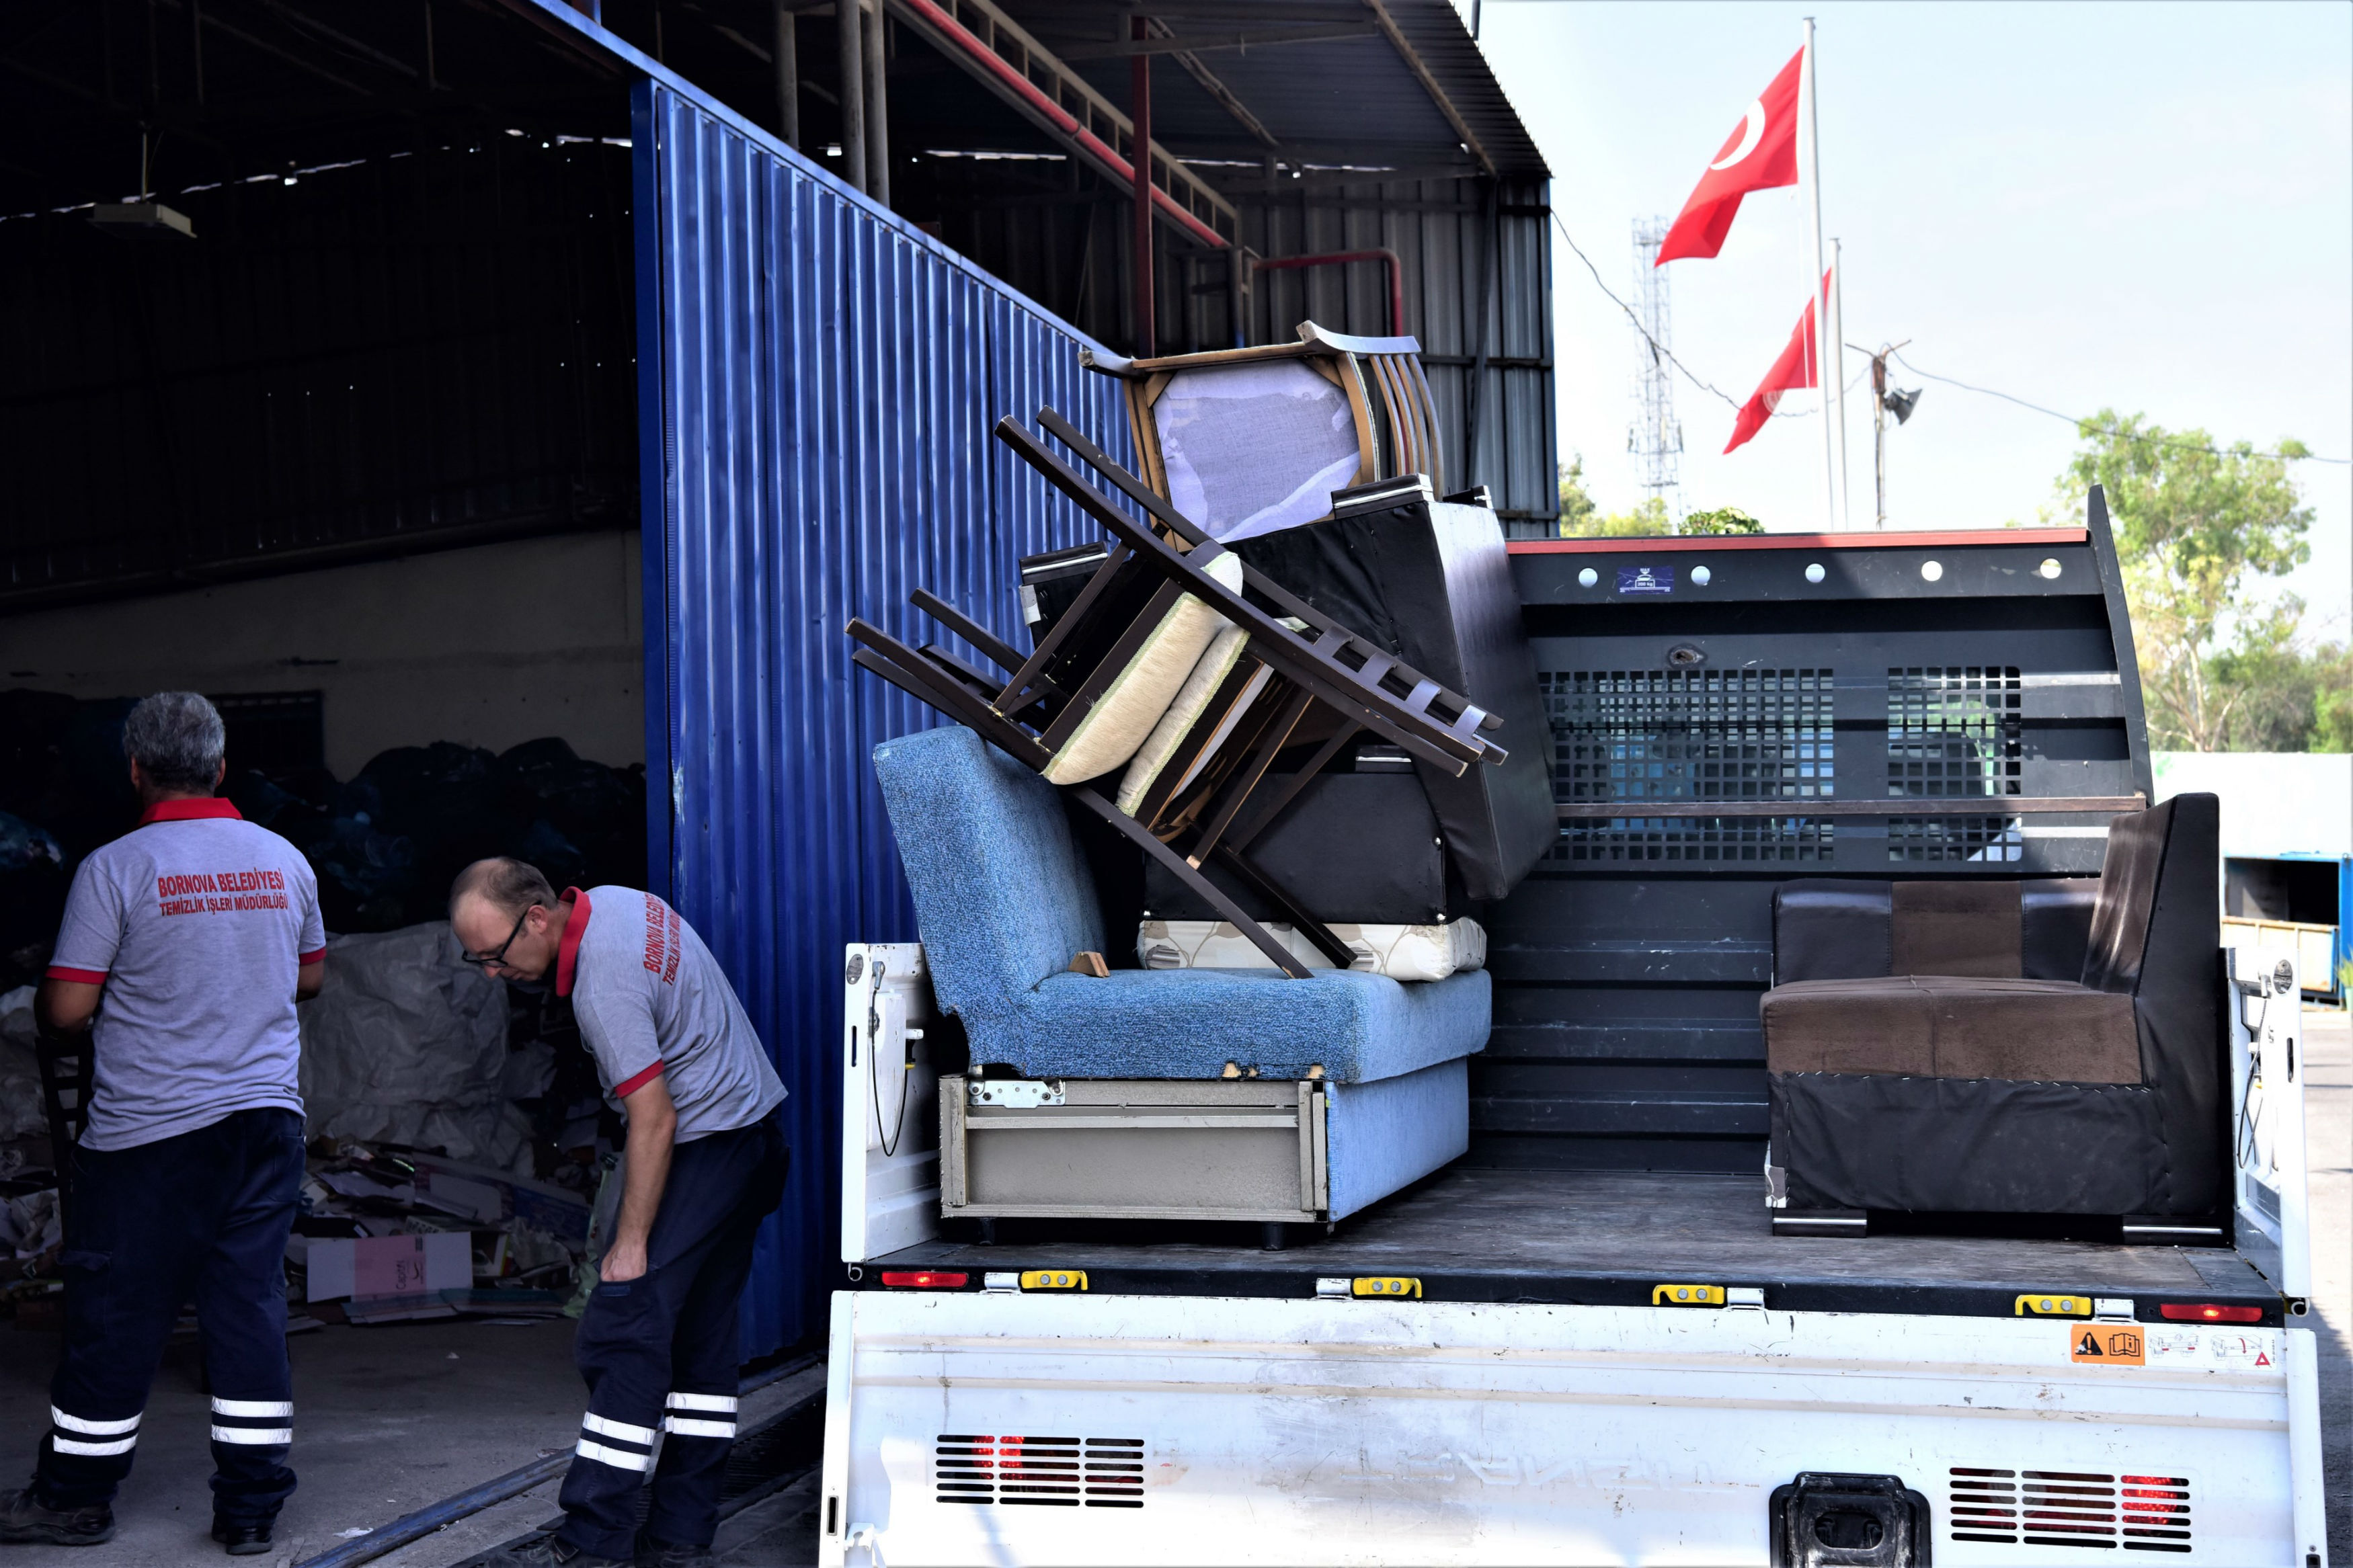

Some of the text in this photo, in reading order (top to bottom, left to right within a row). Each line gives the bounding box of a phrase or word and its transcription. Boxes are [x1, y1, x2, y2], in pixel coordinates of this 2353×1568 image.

[158, 867, 285, 898] BORNOVA BELEDİYESİ
[159, 892, 288, 916] TEMİZLİK İŞLERİ MÜDÜRLÜĞÜ
[643, 925, 665, 974] BORNOVA
[662, 945, 681, 986] TEMİZLİK
